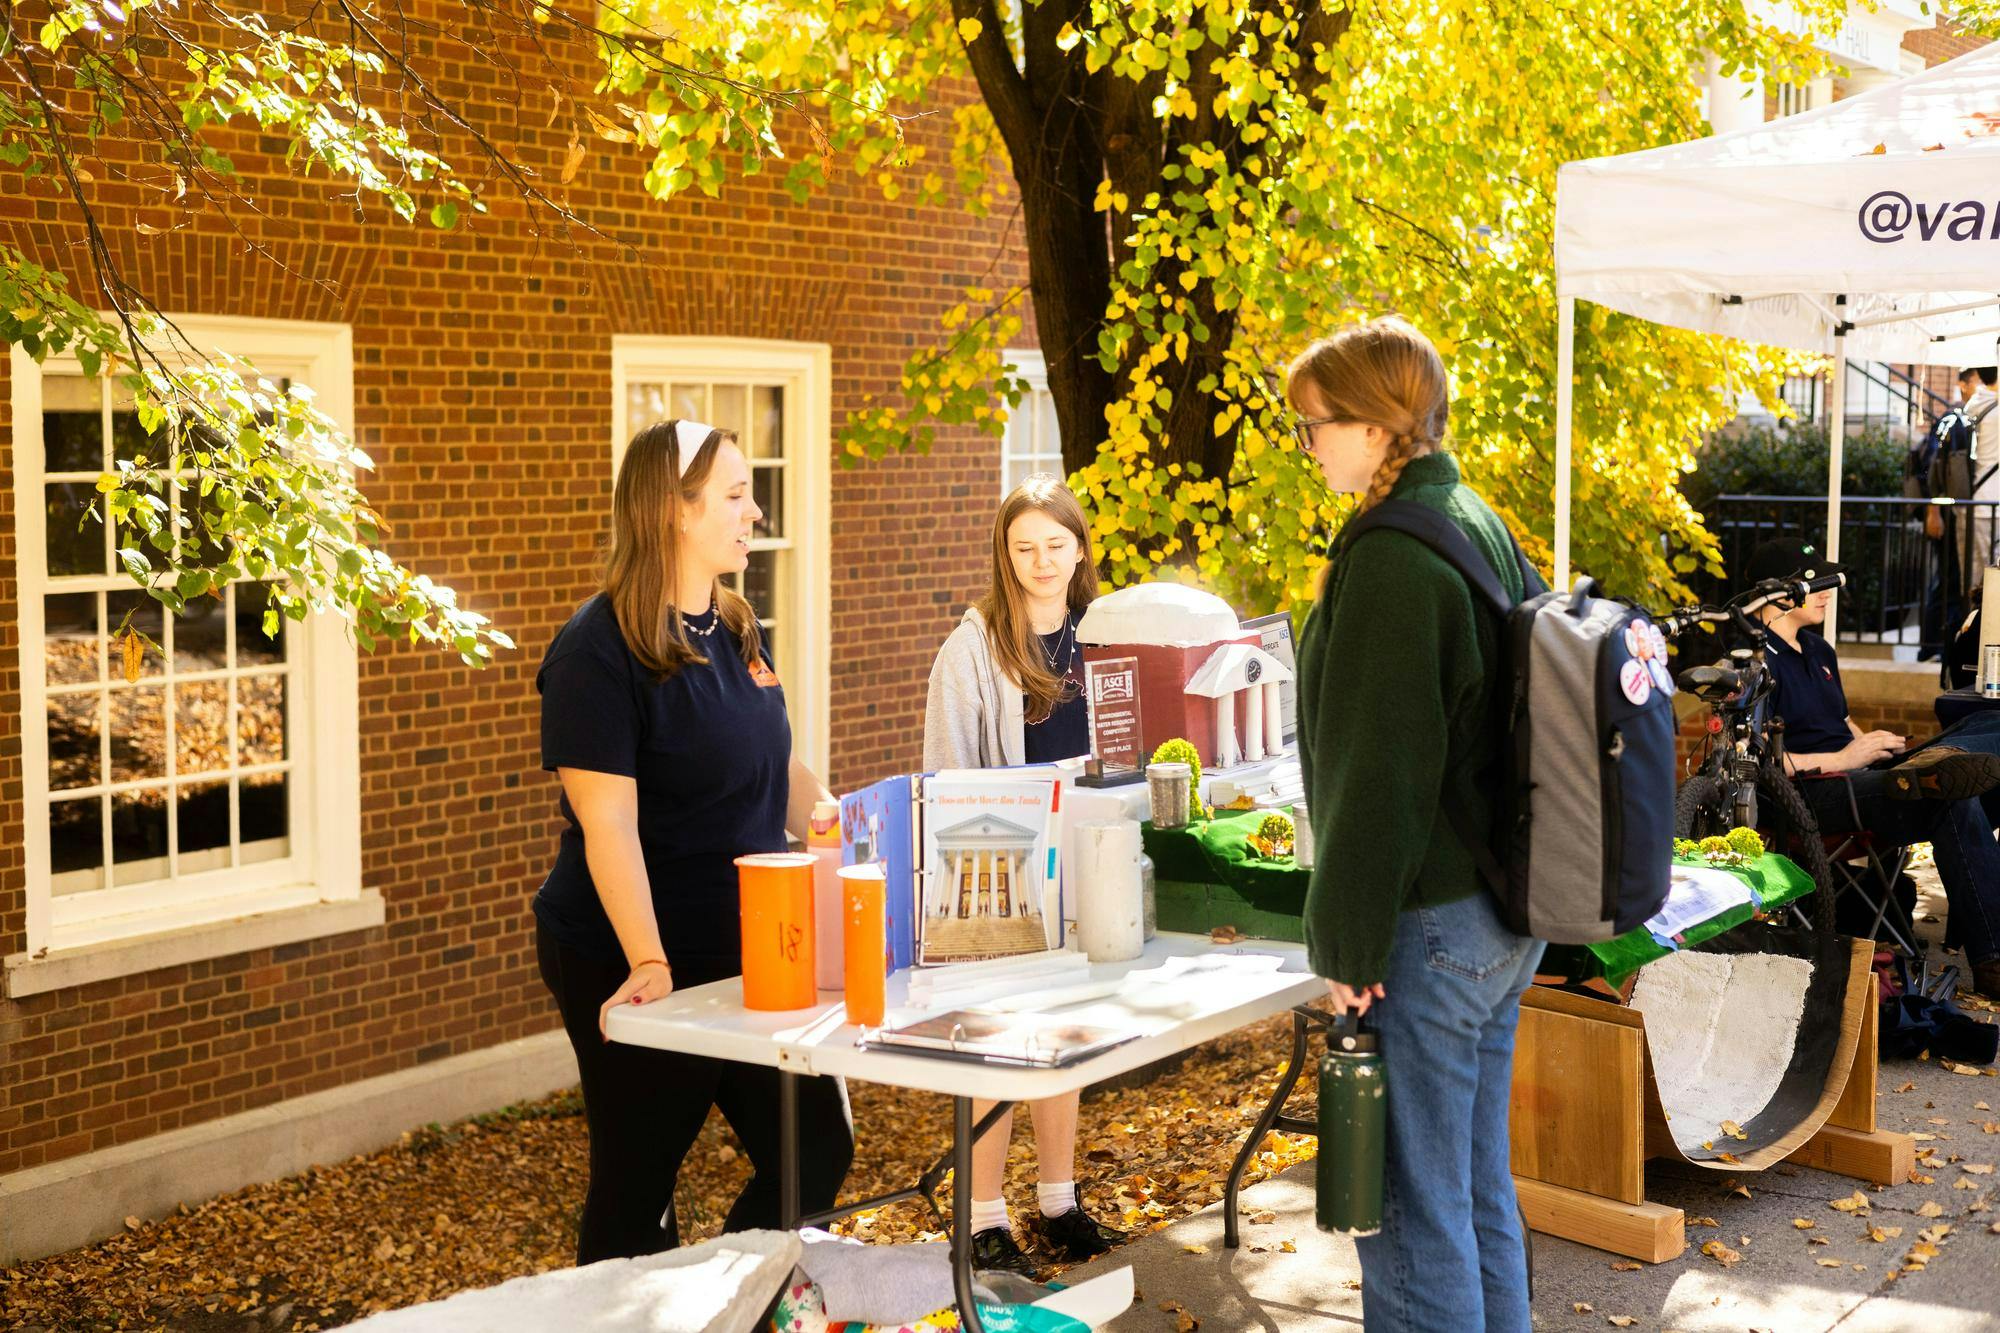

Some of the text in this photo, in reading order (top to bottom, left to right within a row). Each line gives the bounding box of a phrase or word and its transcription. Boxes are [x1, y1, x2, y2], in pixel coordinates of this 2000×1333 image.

[1103, 676, 1124, 689] ASCE
[1104, 744, 1132, 755] FIRST PLACE
